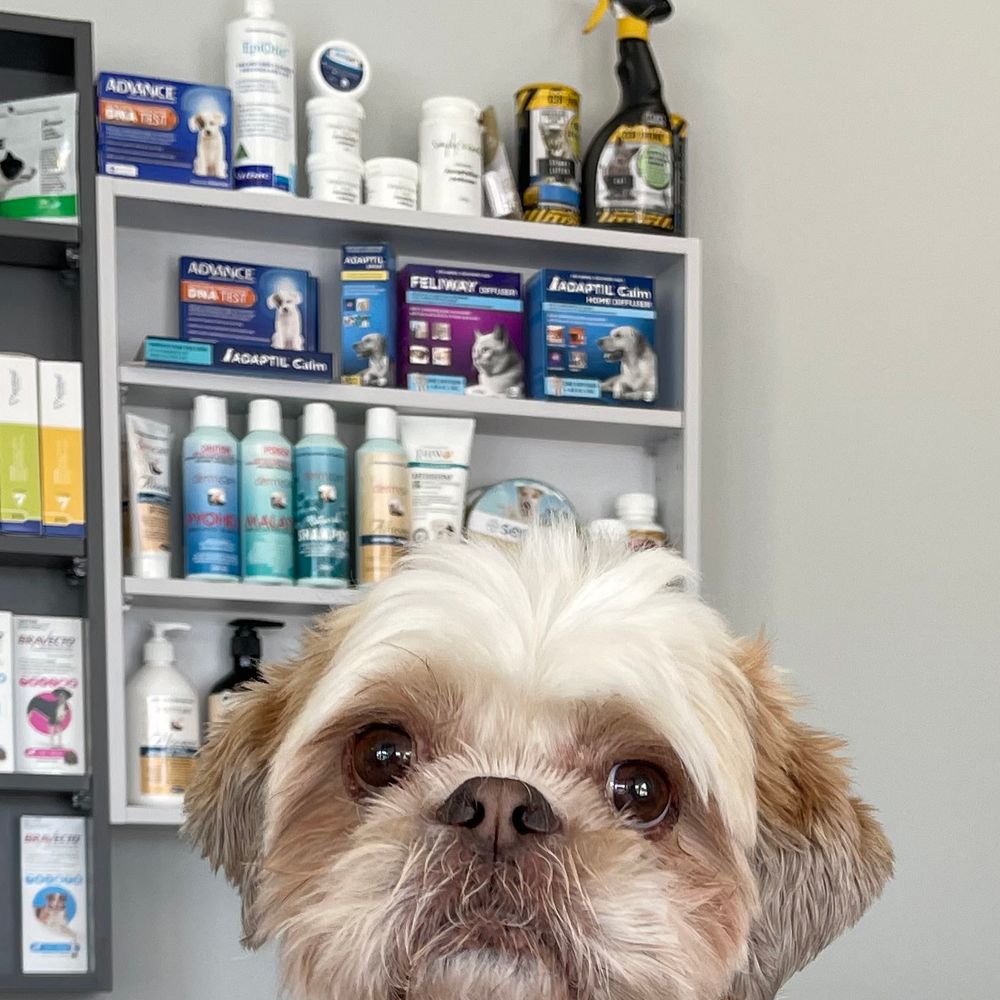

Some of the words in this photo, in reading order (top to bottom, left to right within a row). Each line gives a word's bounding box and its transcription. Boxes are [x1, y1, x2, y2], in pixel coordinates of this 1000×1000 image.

[105, 78, 177, 101] ADVANCE
[188, 262, 256, 282] ADVANCE
[188, 287, 218, 301] DNA
[222, 290, 247, 304] TEST
[558, 280, 616, 296] ADAPTIL
[617, 286, 652, 299] Calm
[233, 352, 289, 368] ADAPTIL
[292, 358, 327, 371] Calm
